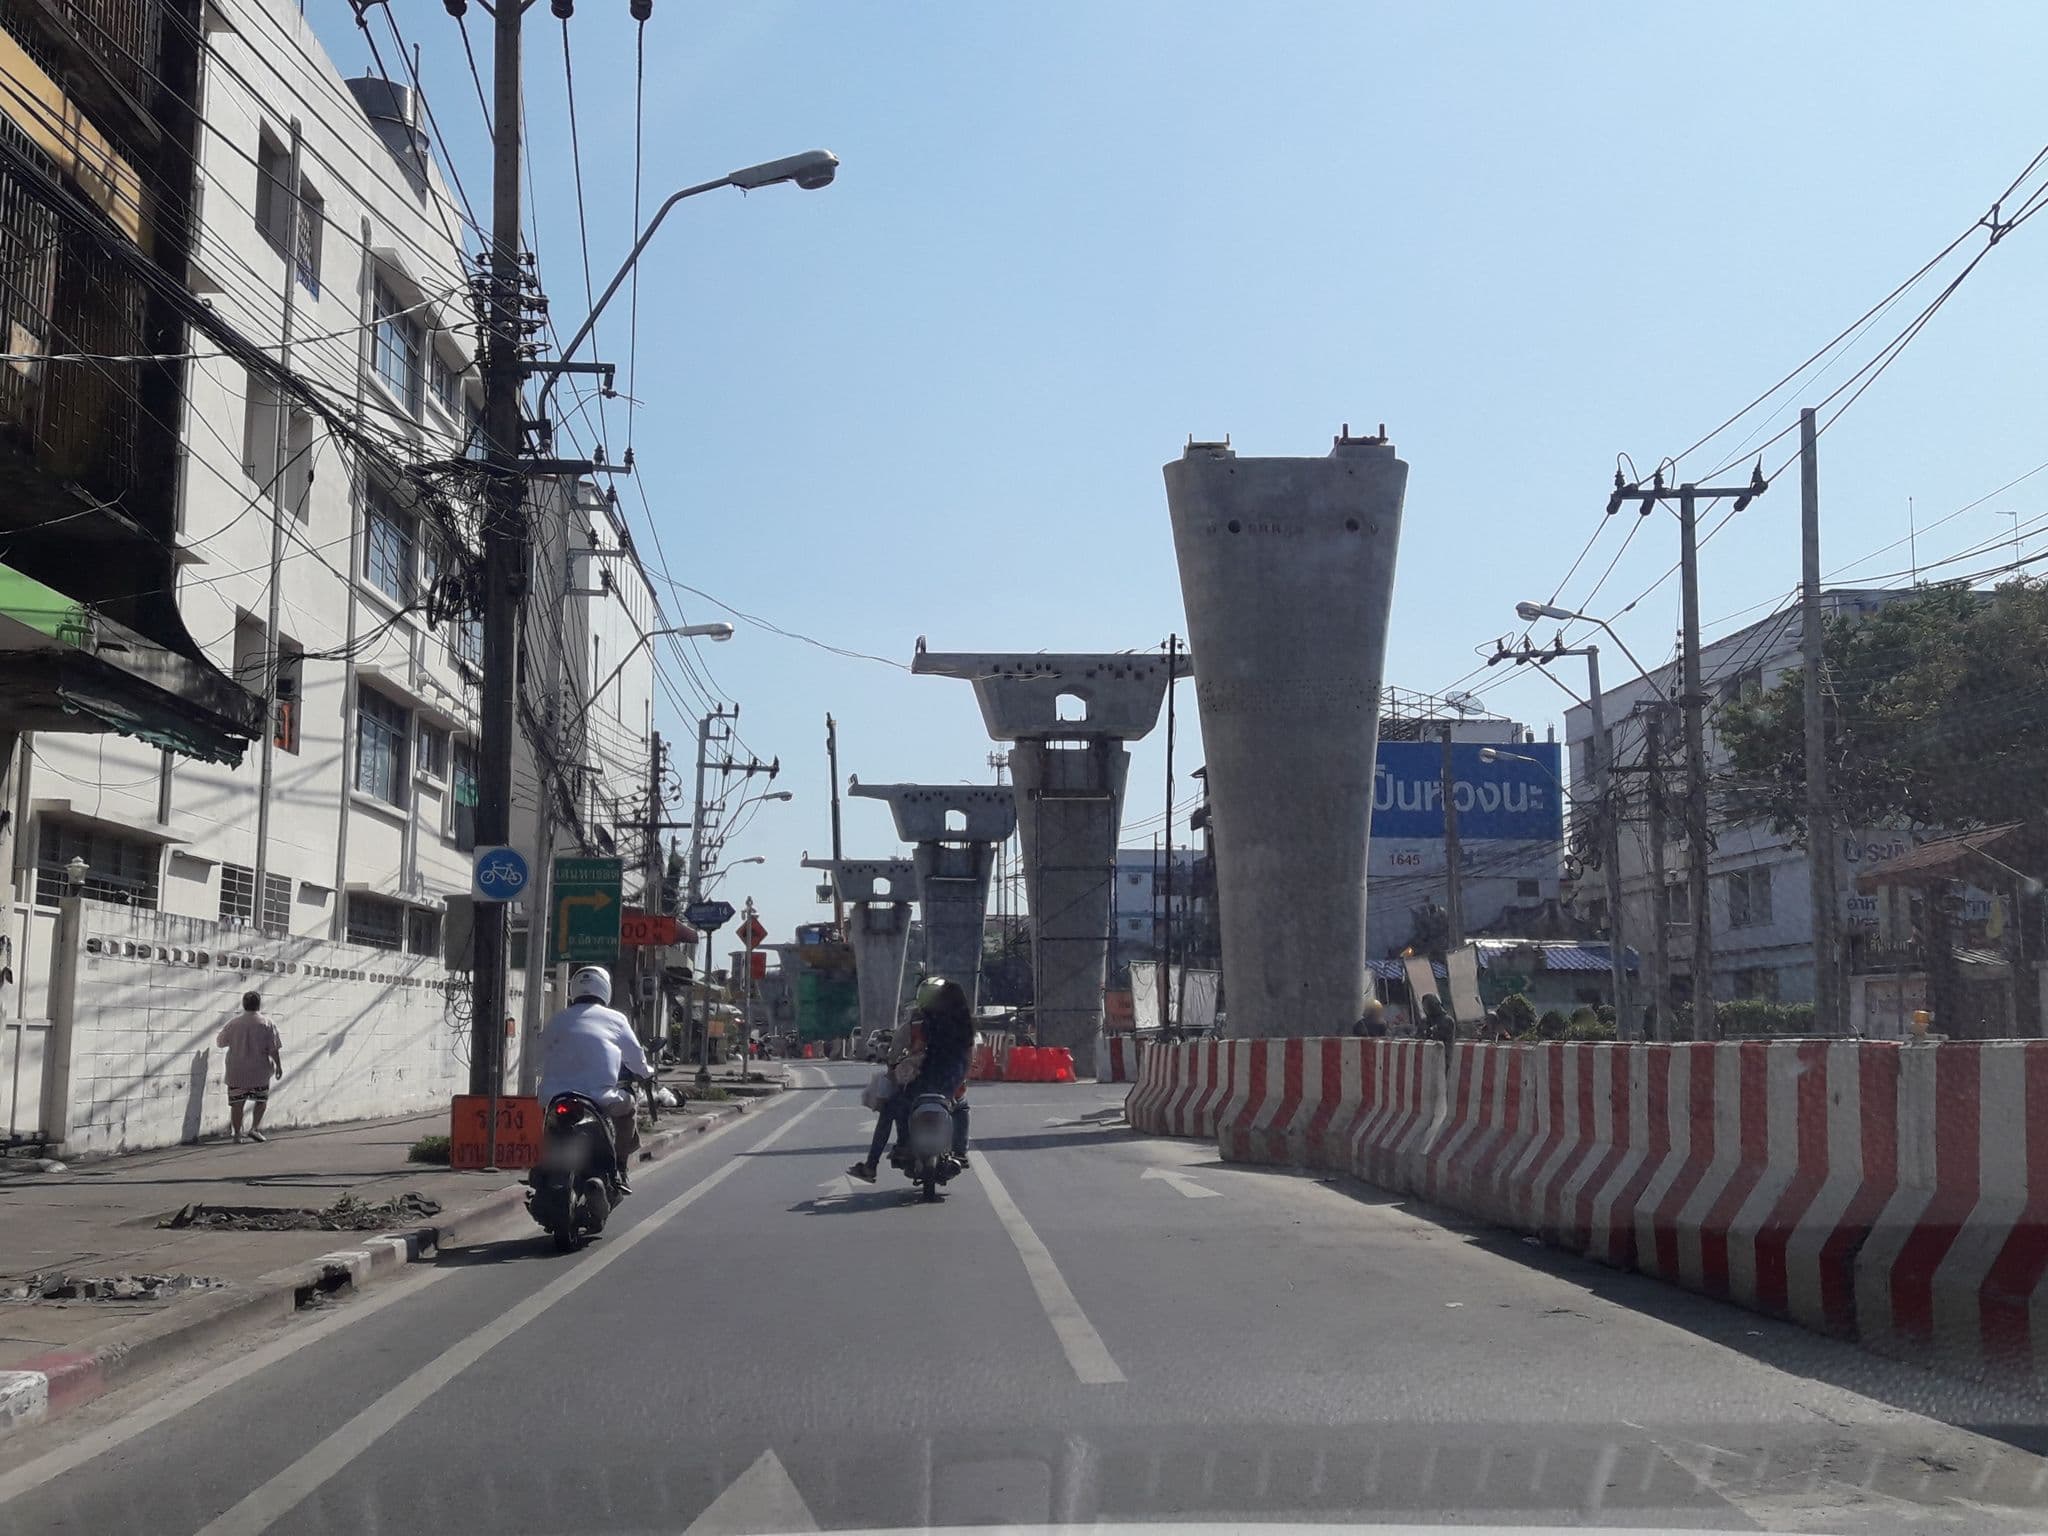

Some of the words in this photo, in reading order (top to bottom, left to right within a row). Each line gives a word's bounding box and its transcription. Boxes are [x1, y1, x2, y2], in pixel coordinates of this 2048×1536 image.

[1374, 764, 1543, 813] ป็นห่วงนะ
[1389, 853, 1421, 866] 1645
[621, 922, 647, 938] 00
